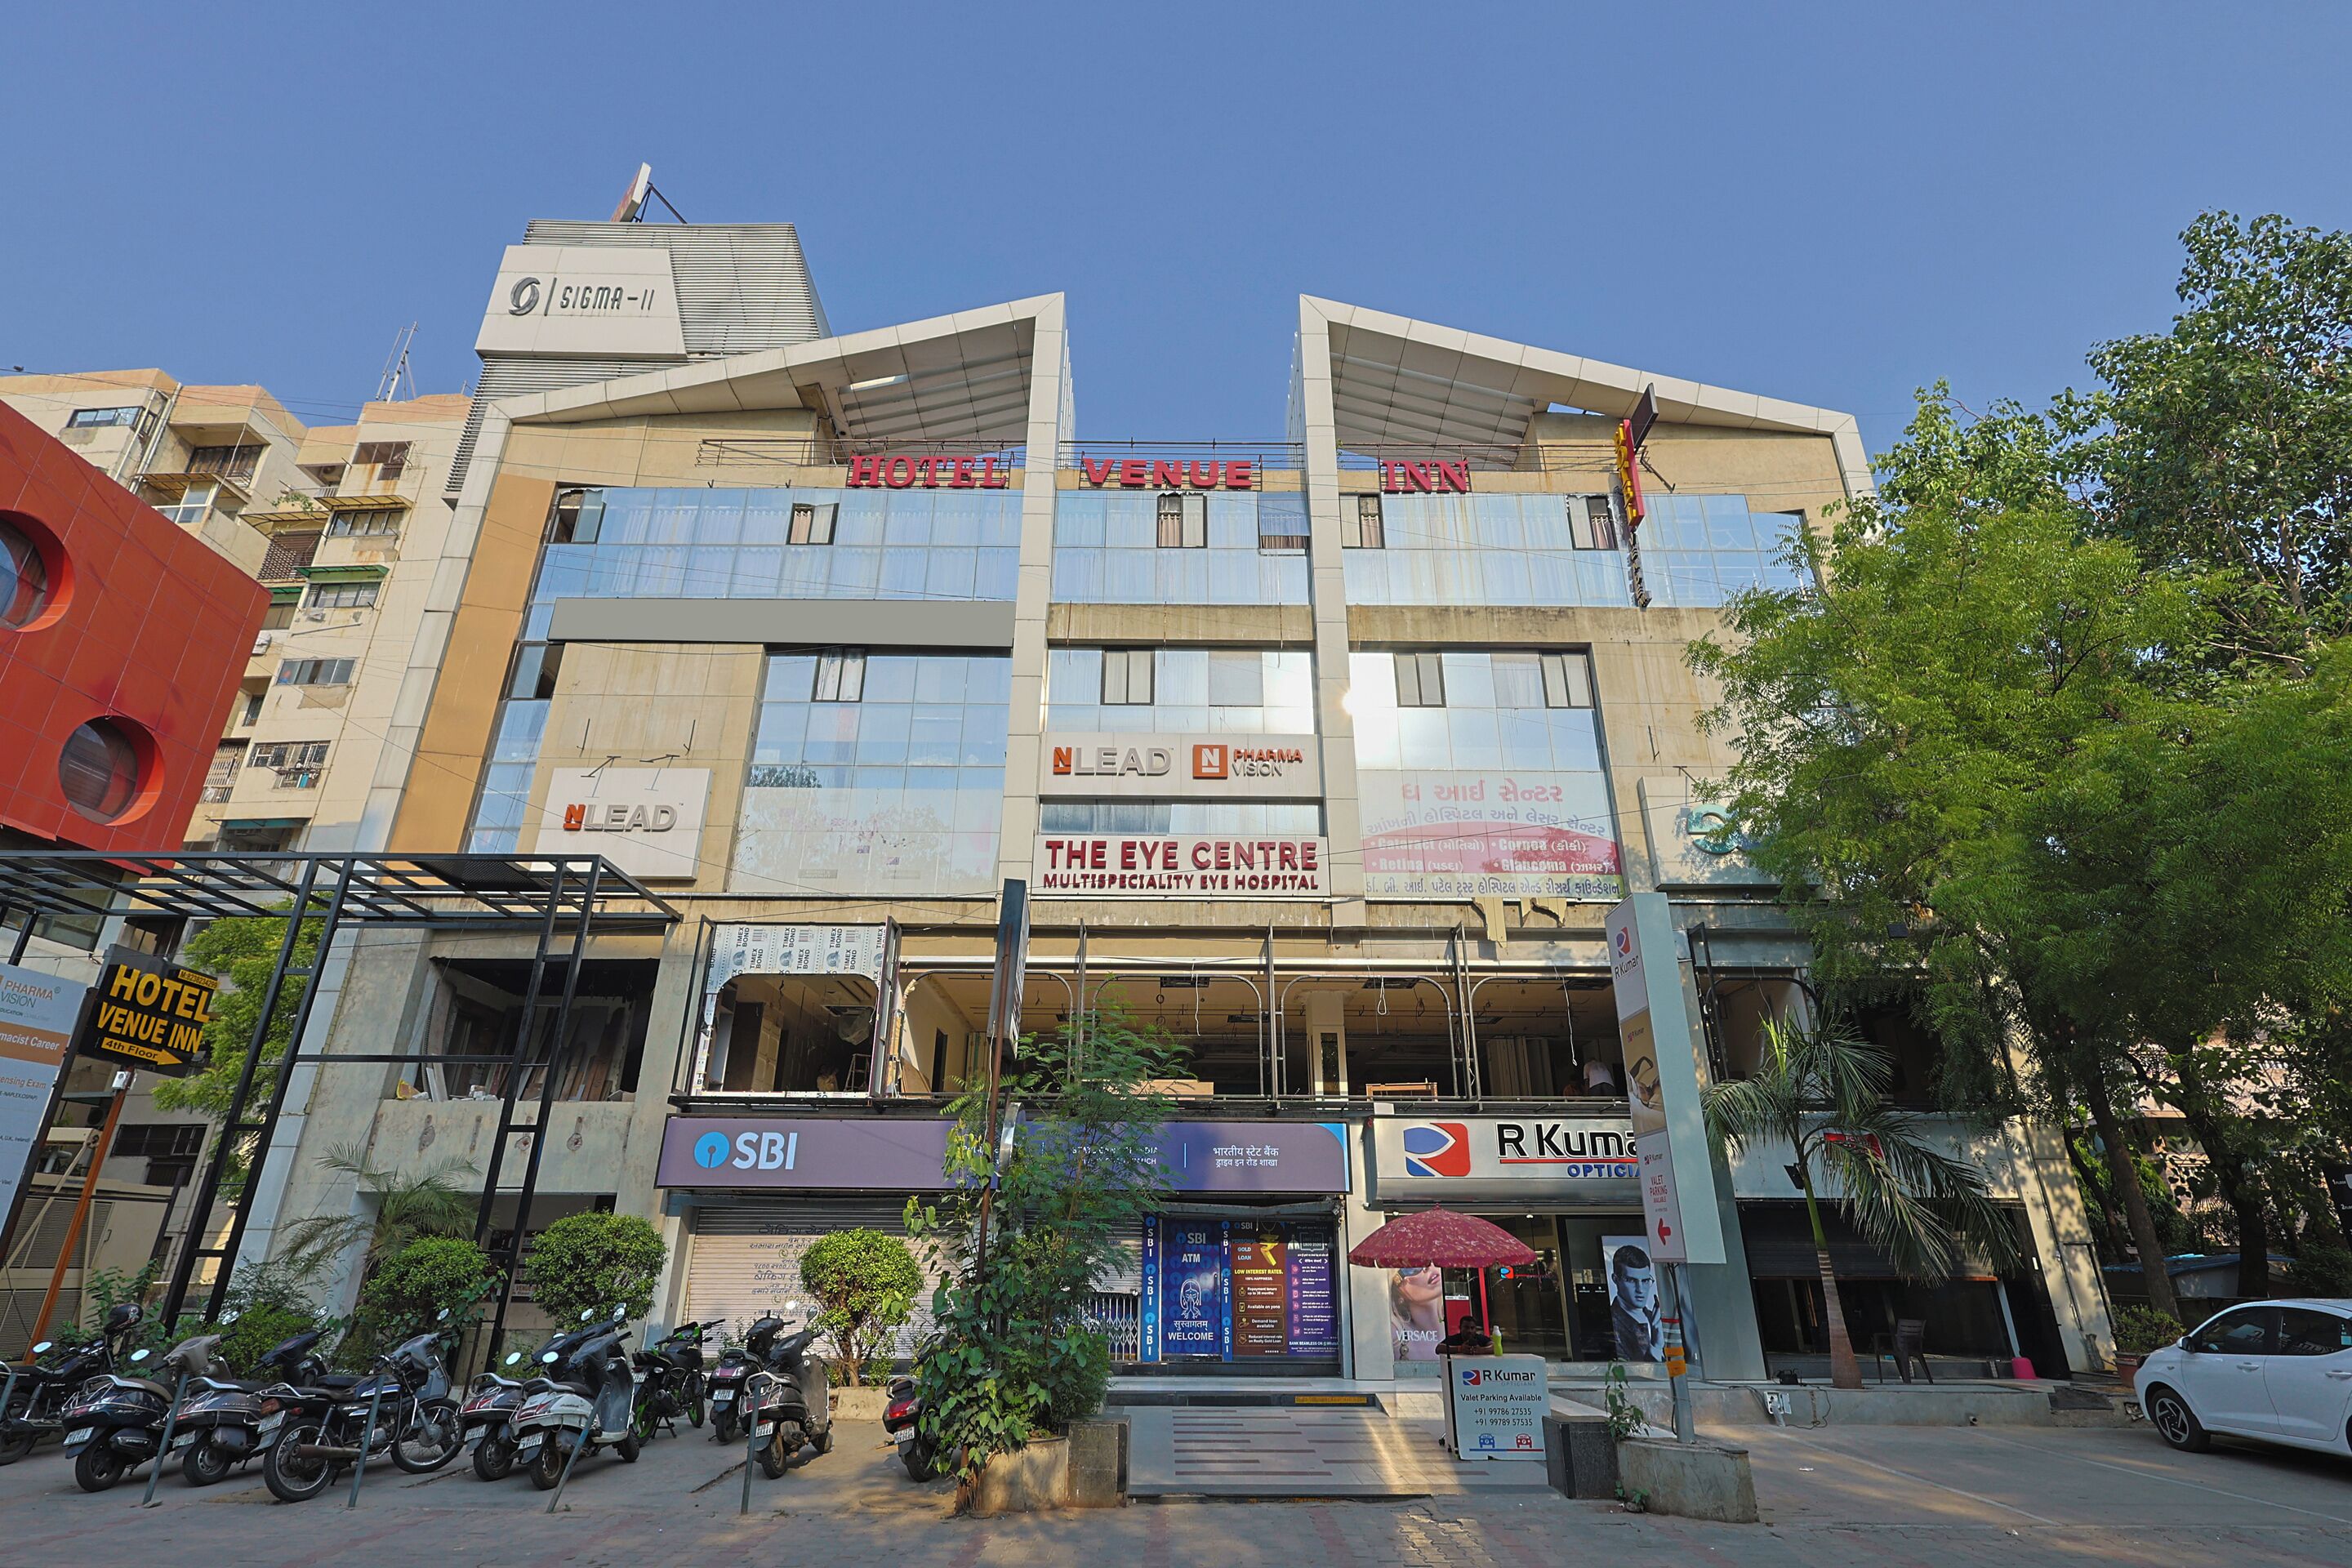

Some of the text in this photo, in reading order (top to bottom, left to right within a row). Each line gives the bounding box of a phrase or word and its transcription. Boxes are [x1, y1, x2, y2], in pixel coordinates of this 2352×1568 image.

[848, 456, 1468, 493] HOTEL VENUE INN
[1233, 749, 1303, 764] PHARMA
[1232, 762, 1283, 777] VISION
[1490, 806, 1517, 822] અને
[1499, 838, 1548, 851] Cornea
[1045, 840, 1319, 871] THE EYE CENTRE
[1379, 858, 1423, 871] Retina
[1501, 858, 1566, 871] Glaucoma
[1043, 873, 1319, 890] MULTISPECIALITY EYE HOSPITAL
[5, 980, 53, 1000] PHARMA
[109, 964, 210, 1023] HOTEL
[1, 991, 37, 1009] VISION
[97, 1001, 203, 1055] VENUE INN
[30, 1036, 60, 1050] Career
[105, 1040, 158, 1060] 4th Floor
[26, 1079, 47, 1089] Exam
[1496, 1123, 1530, 1158] R
[732, 1131, 799, 1170] SBI
[1213, 1145, 1280, 1156] भारतीय स्टेट बैंक
[1215, 1156, 1278, 1169] ड्राइव इन रोड शाखा
[1650, 1174, 1664, 1185] VALET
[1650, 1185, 1668, 1196] PARKING
[1187, 1232, 1206, 1245] SBI
[1182, 1254, 1200, 1263] ATM
[1174, 1320, 1209, 1331] सुस्वागतम्
[1168, 1332, 1214, 1341] WELCOME
[1396, 1330, 1437, 1342] VERSACE
[1482, 1370, 1536, 1381] R Kumar
[1480, 1394, 1508, 1403] Parking
[1488, 1407, 1510, 1415] 99786
